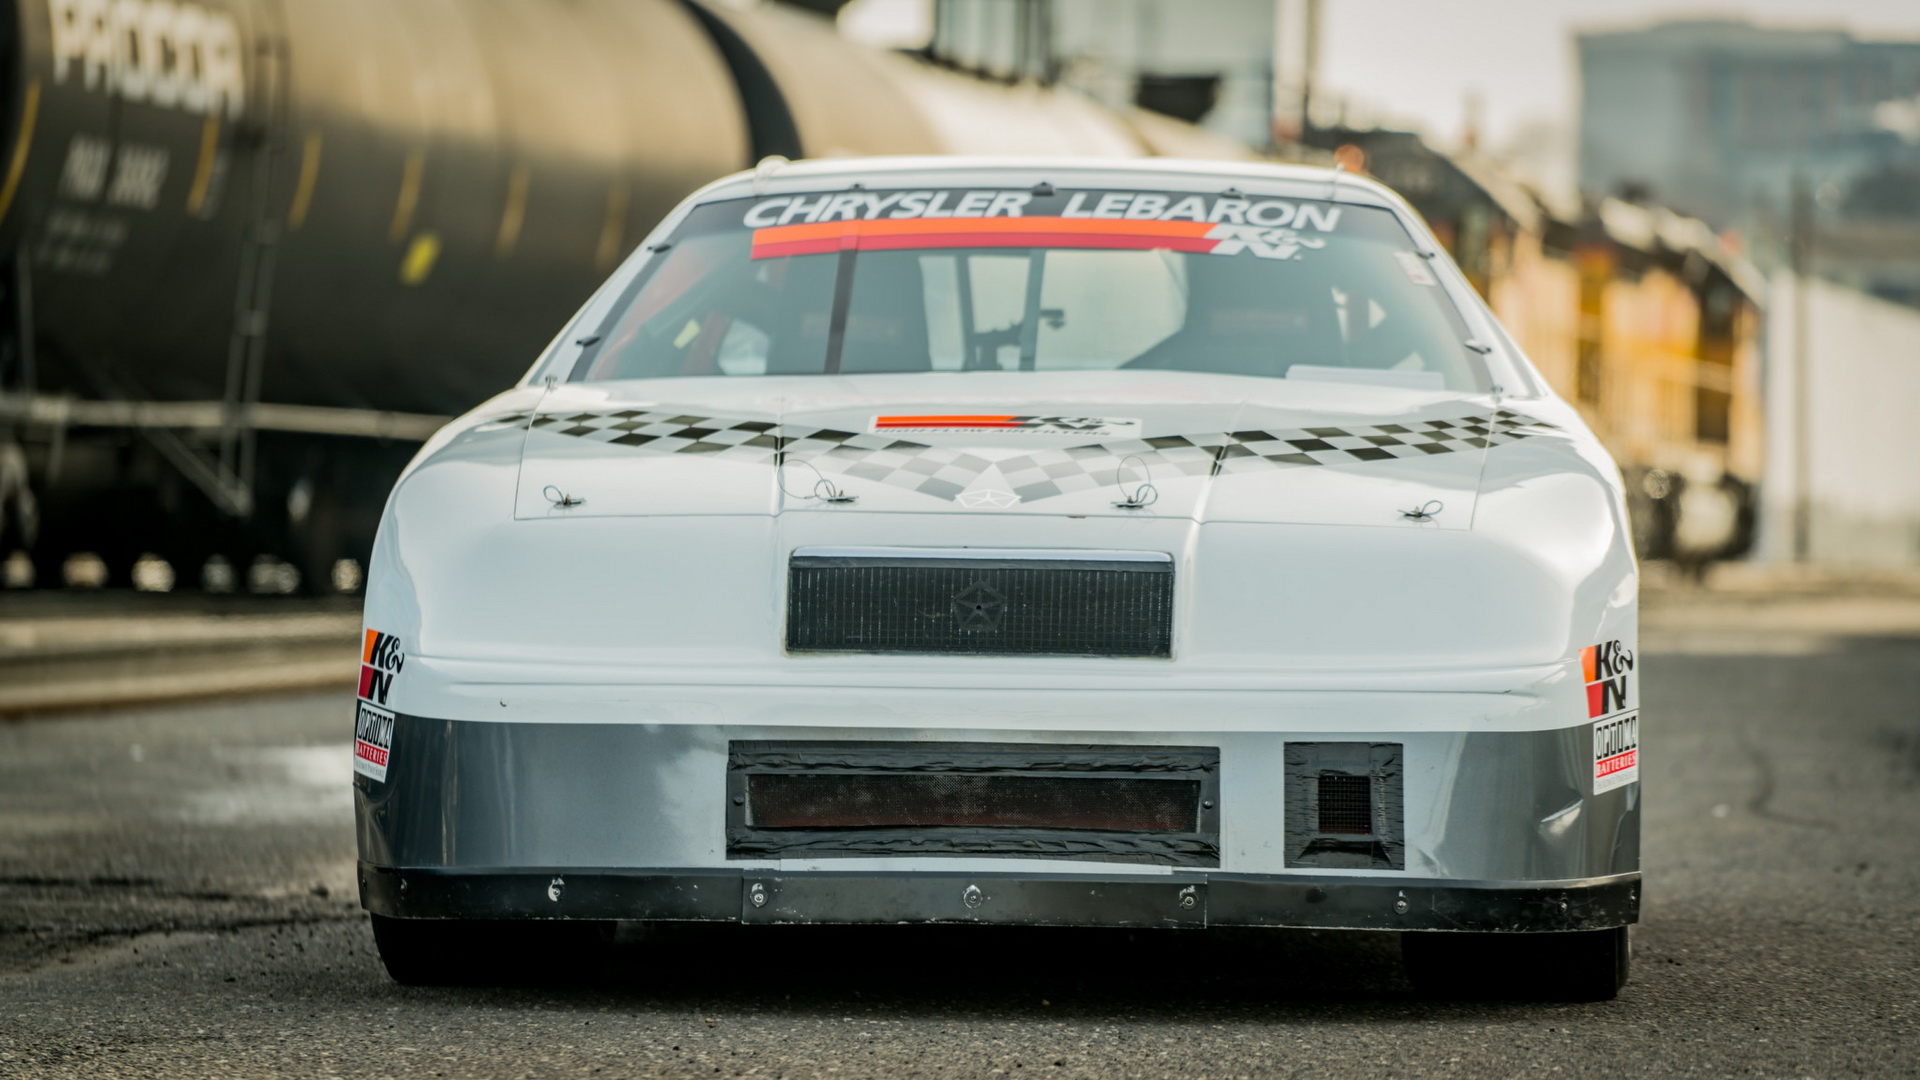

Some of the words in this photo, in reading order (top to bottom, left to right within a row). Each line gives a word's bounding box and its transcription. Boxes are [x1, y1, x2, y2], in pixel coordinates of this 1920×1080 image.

[743, 191, 1032, 229] CHRYSLER
[1061, 191, 1341, 233] LEBARON
[357, 708, 393, 750] OPTIMA
[1596, 716, 1637, 760] OPTIMA
[355, 741, 388, 767] BATTERIES
[1595, 752, 1637, 777] BATTERIES
